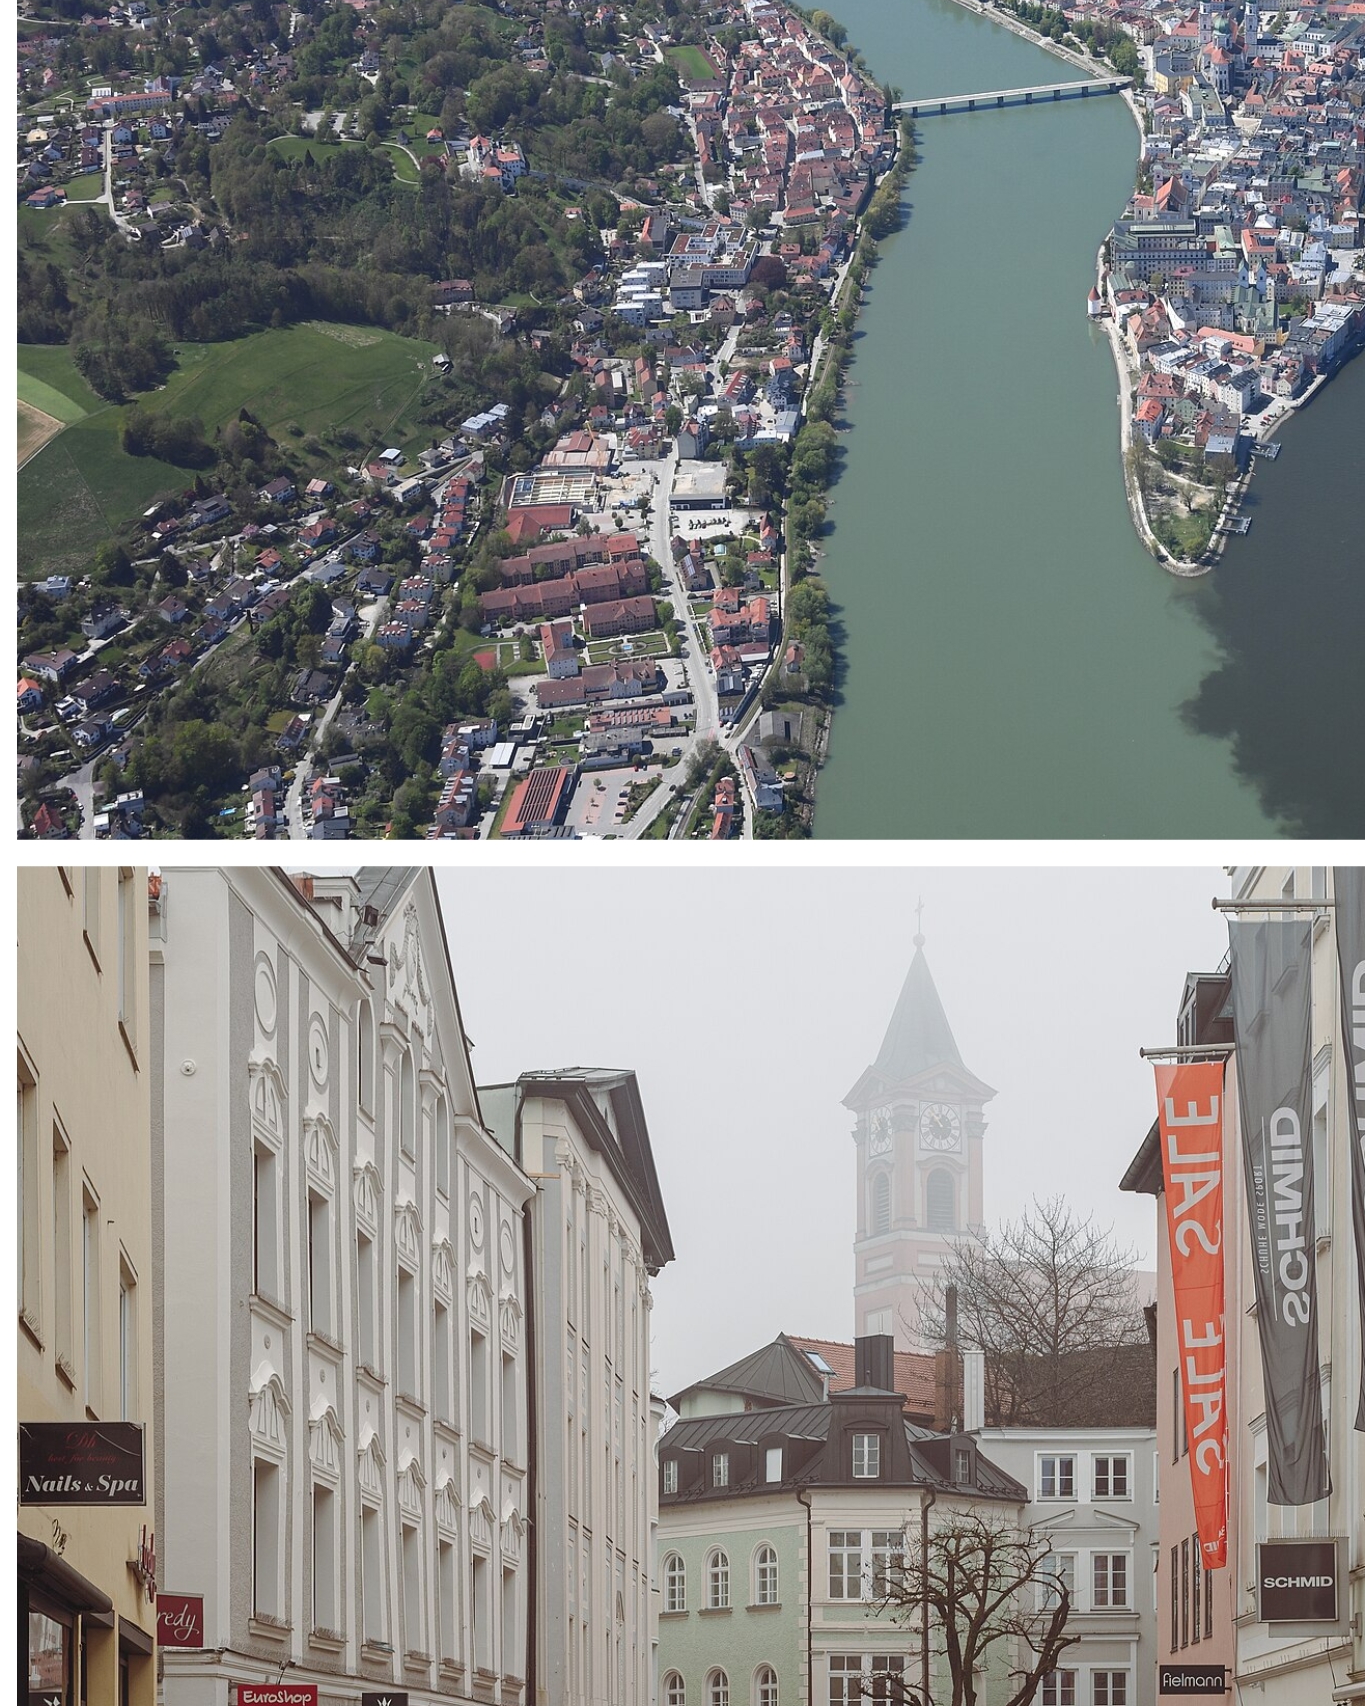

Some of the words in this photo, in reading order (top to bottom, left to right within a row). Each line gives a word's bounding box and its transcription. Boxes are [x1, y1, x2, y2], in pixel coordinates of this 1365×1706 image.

[25, 1475, 81, 1492] Nails
[84, 1483, 94, 1492] &
[96, 1474, 139, 1496] Spa
[1263, 1575, 1333, 1588] SCHMID
[156, 1604, 200, 1641] redy
[1163, 1672, 1223, 1687] fielmann
